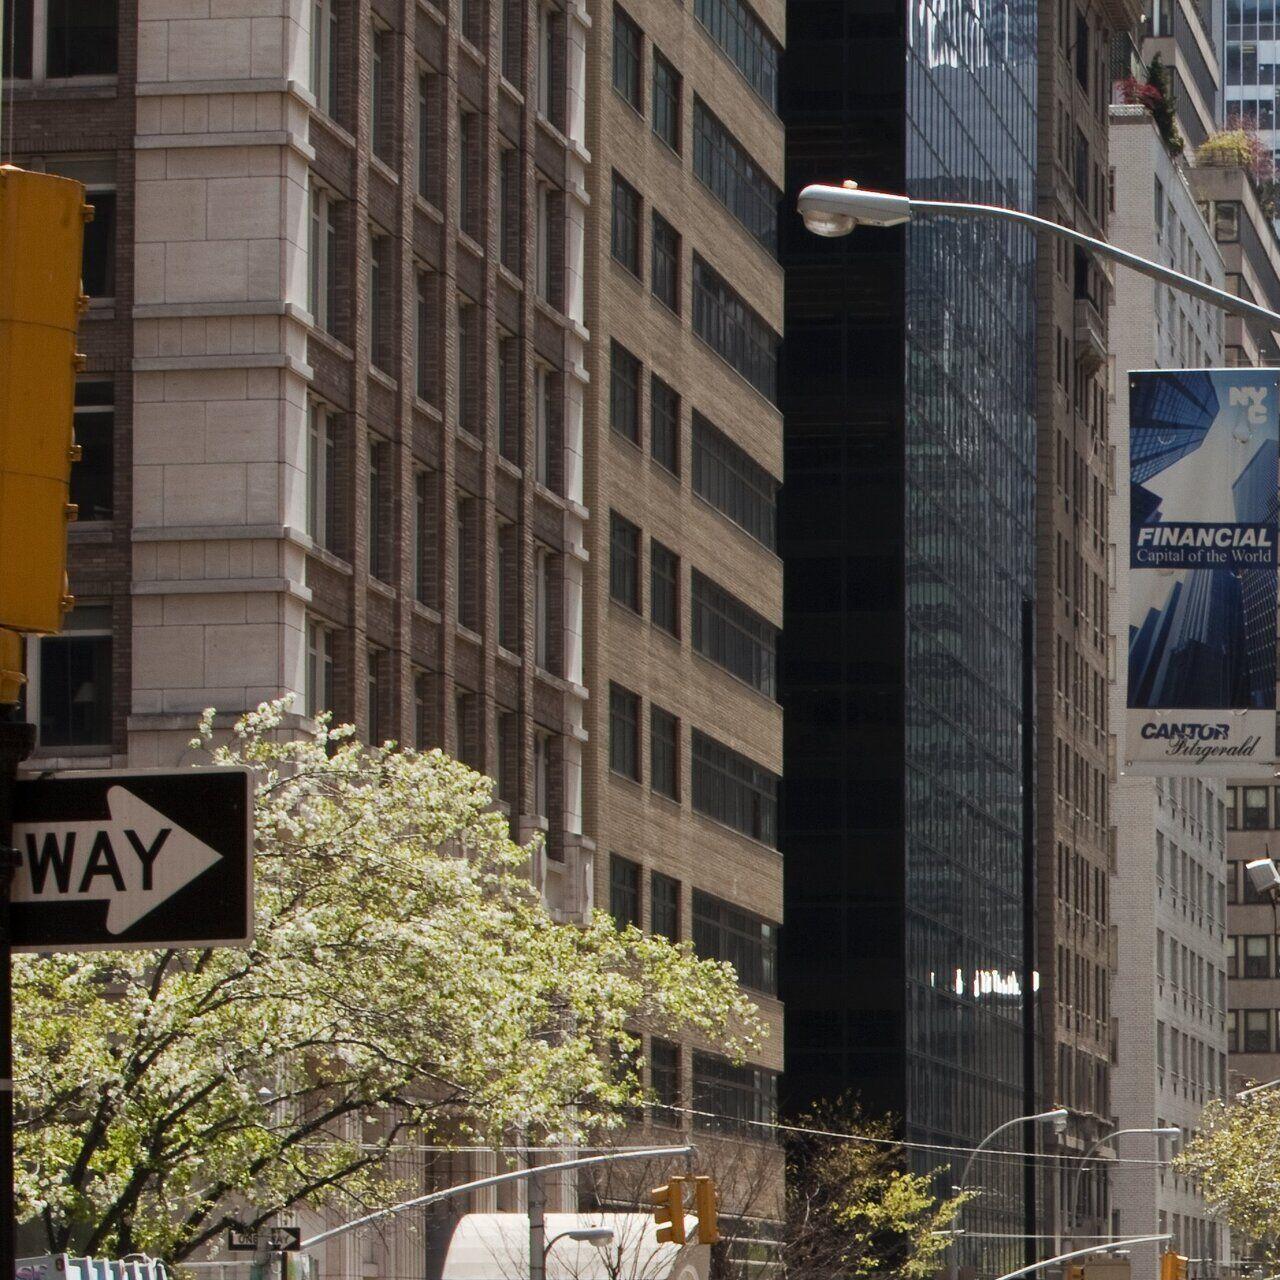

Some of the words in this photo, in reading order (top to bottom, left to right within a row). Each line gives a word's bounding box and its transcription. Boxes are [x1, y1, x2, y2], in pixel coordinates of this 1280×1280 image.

[1137, 527, 1272, 547] FINANCIAL
[1136, 549, 1184, 564] Capital
[1188, 549, 1206, 562] of
[1206, 549, 1228, 562] the
[1232, 550, 1272, 563] World
[1141, 723, 1230, 740] CANTOR
[26, 828, 172, 894] WAY
